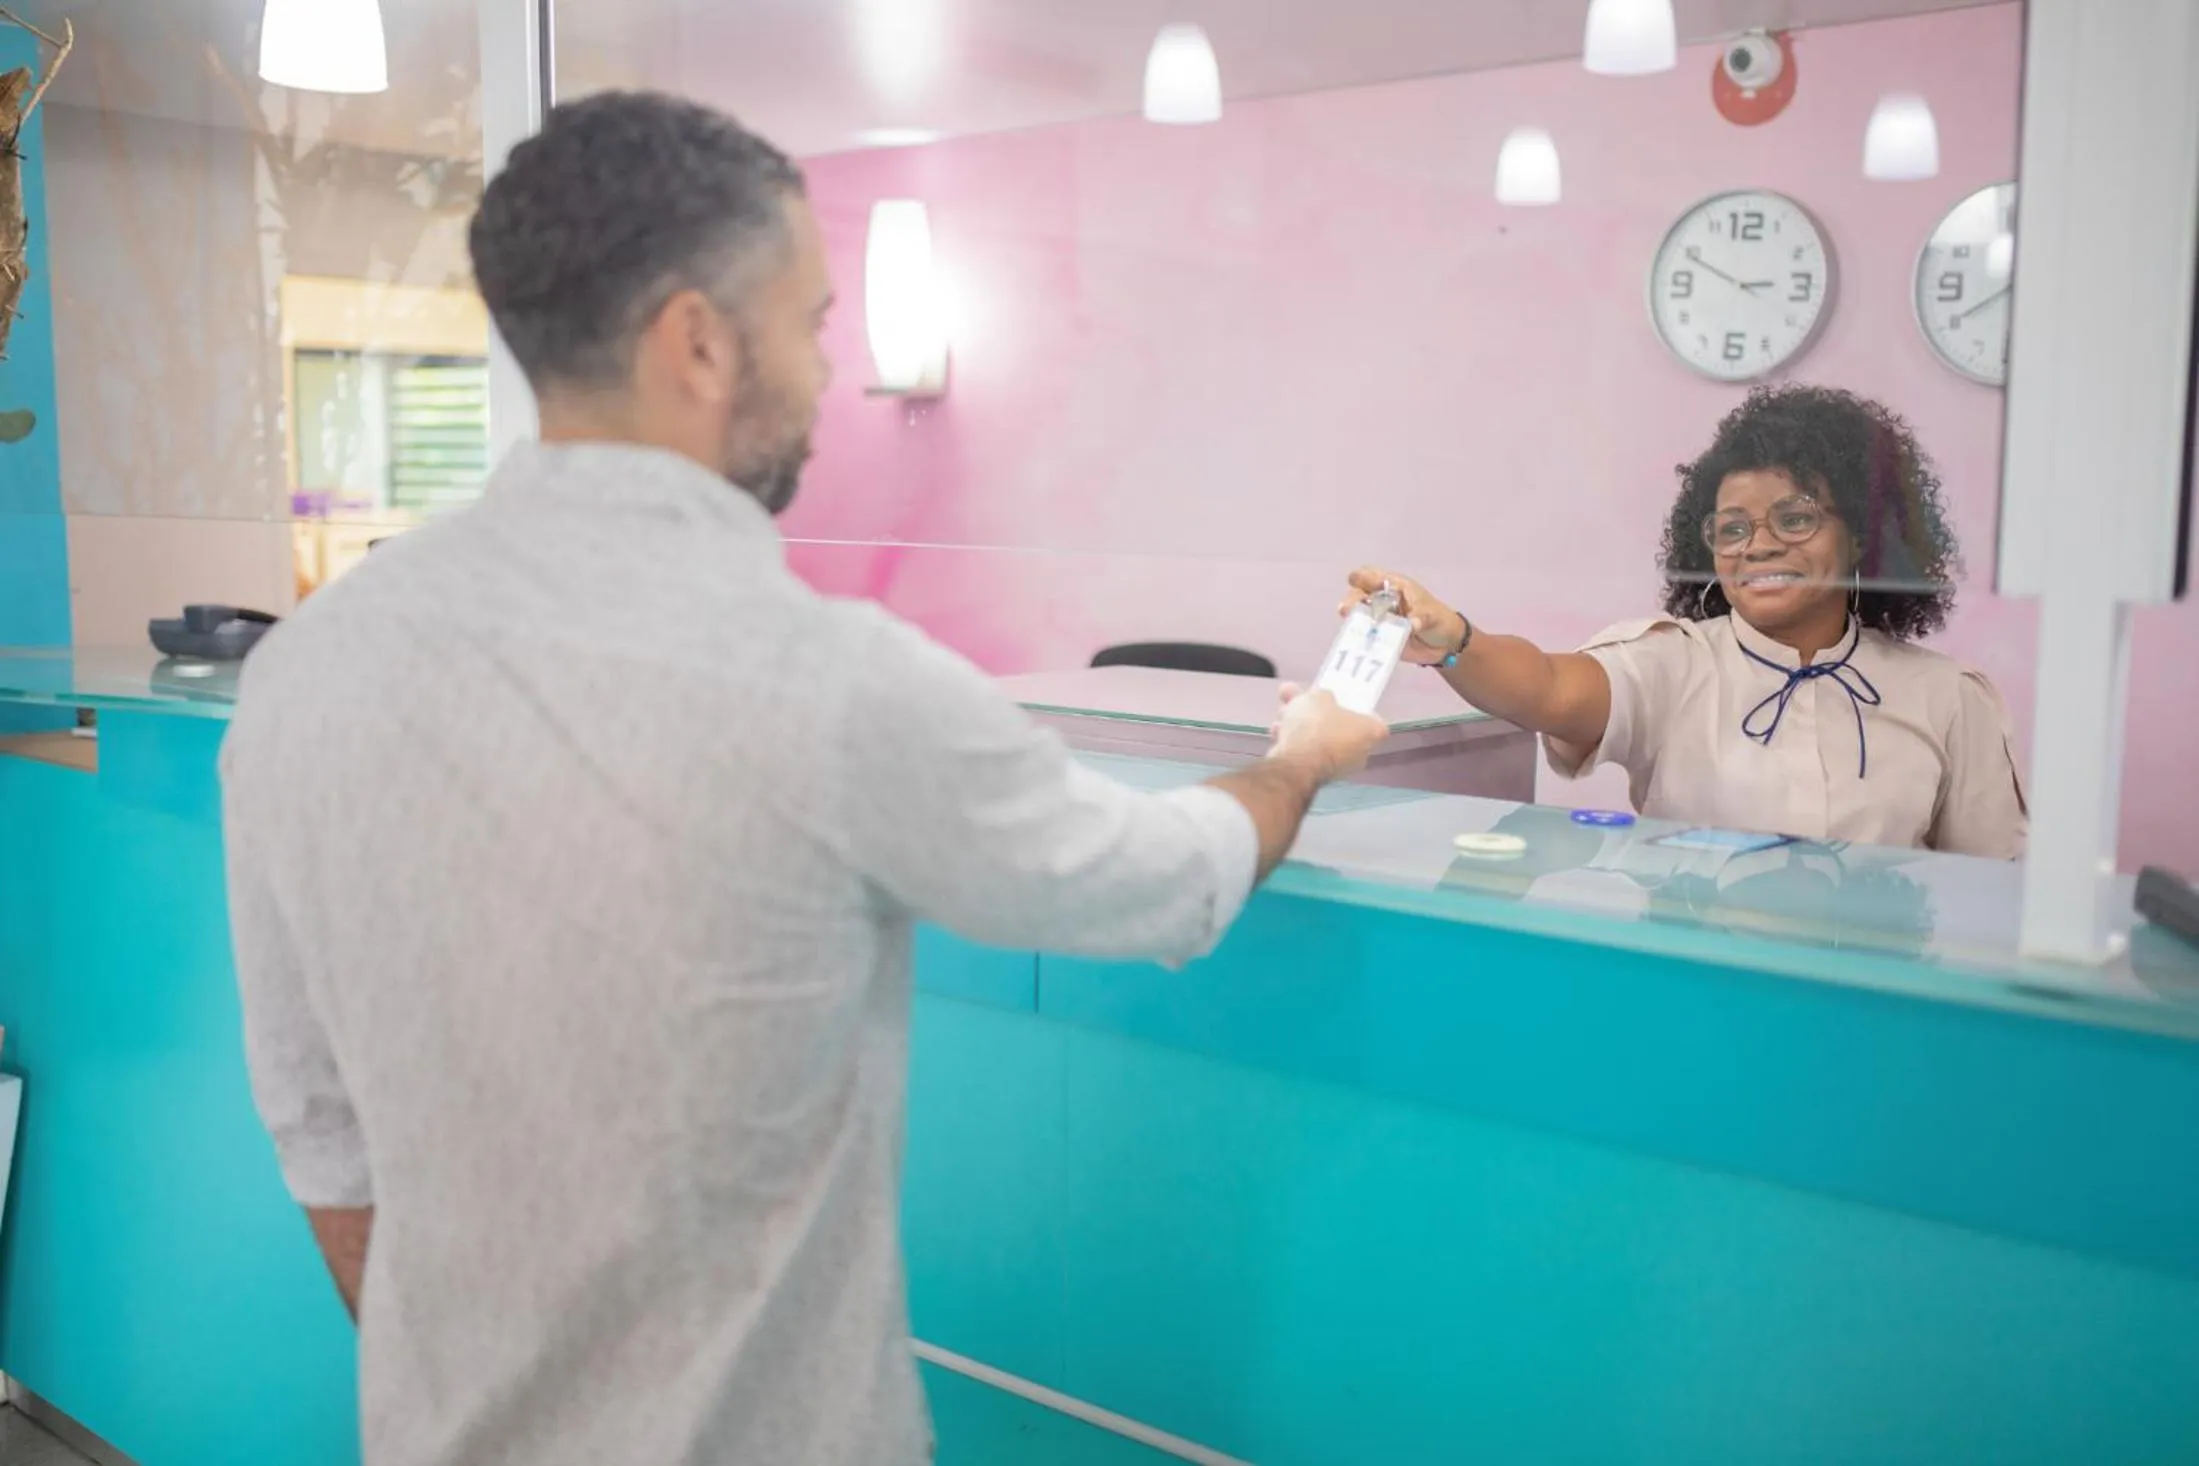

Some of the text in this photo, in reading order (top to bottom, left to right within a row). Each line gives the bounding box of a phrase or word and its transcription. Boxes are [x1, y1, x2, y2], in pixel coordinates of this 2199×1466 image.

[1729, 212, 1764, 240] 12
[1671, 271, 1694, 299] 9
[1788, 272, 1813, 302] 3
[1937, 271, 1963, 302] 9
[1722, 332, 1746, 361] 6
[1334, 650, 1384, 682] 117
